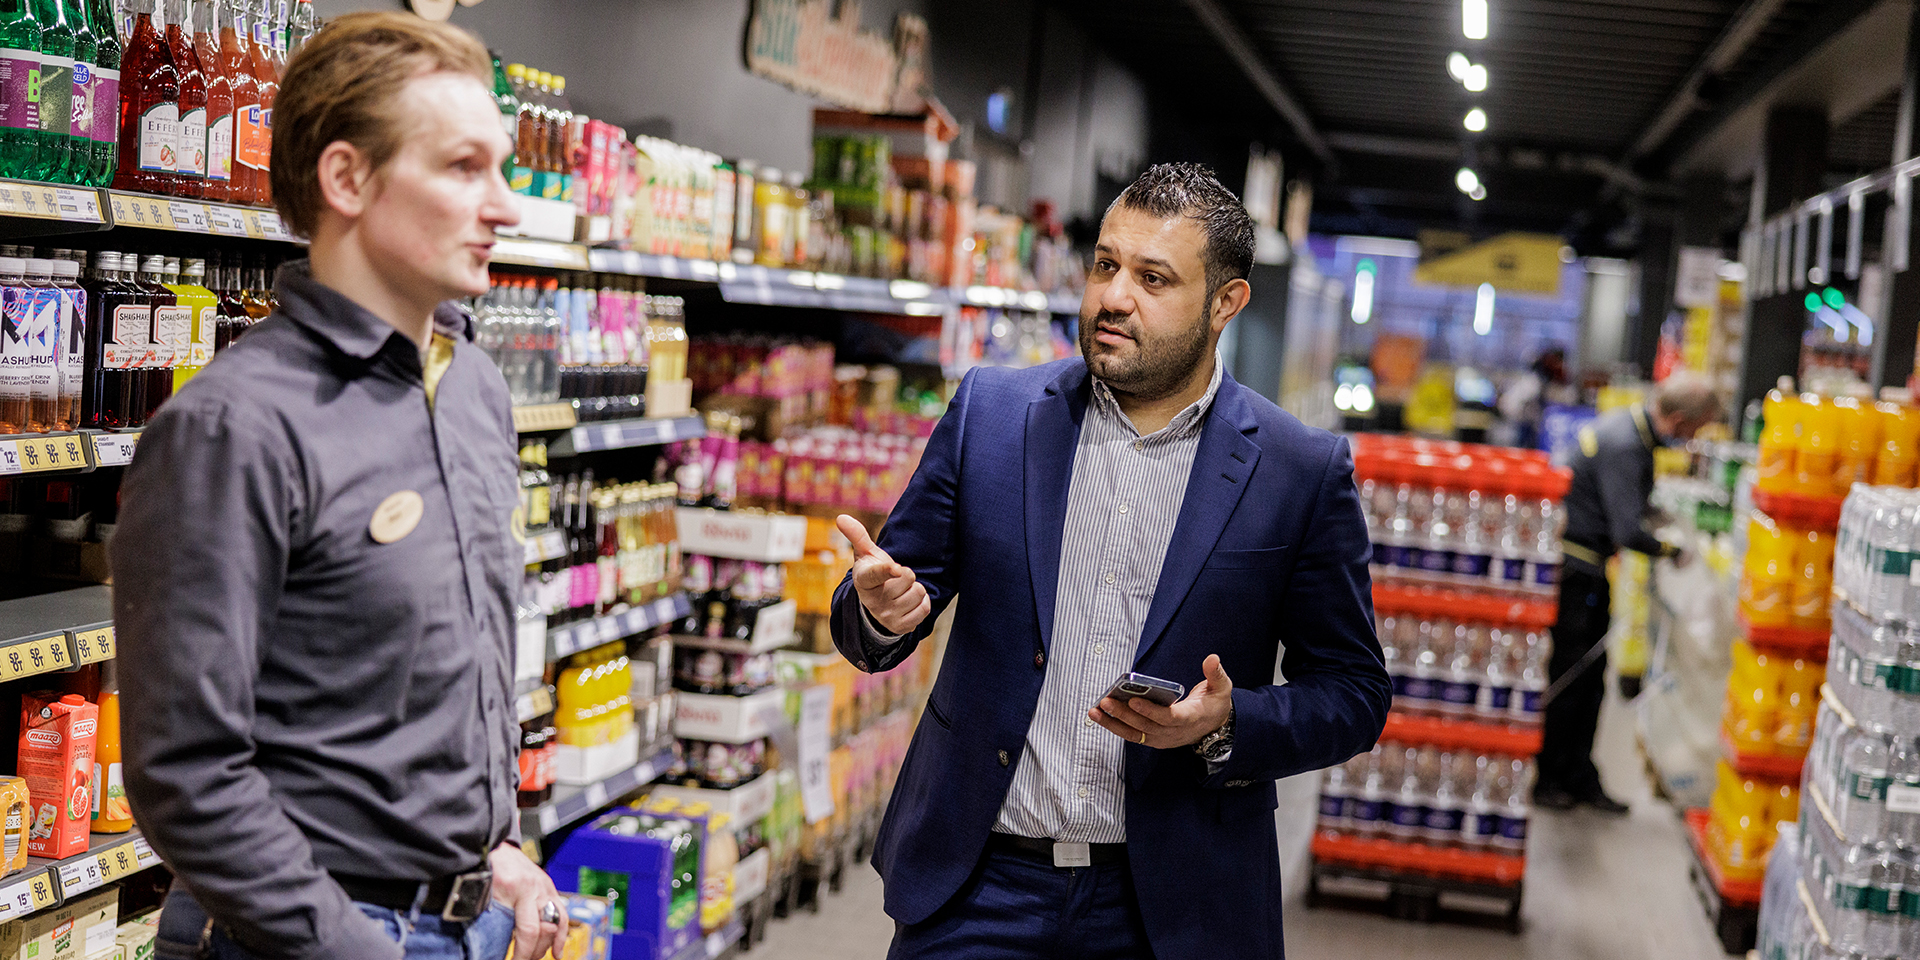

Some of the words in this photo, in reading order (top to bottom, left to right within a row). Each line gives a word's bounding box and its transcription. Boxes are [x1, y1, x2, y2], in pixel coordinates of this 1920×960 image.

[22, 190, 32, 201] SP
[43, 193, 53, 204] SP
[26, 200, 36, 211] OT
[47, 202, 57, 213] OT
[87, 201, 94, 214] 8
[112, 200, 122, 210] SP
[131, 202, 140, 212] SP
[150, 204, 159, 214] SP
[116, 209, 126, 220] OT
[135, 211, 145, 222] OT
[153, 213, 163, 223] OT
[193, 213, 203, 225] 22
[232, 218, 242, 229] 22
[24, 445, 35, 457] SP
[45, 444, 55, 455] SP
[66, 442, 75, 453] SP
[120, 444, 131, 456] 50
[4, 451, 15, 464] 12
[29, 454, 39, 465] OT
[50, 452, 59, 463] OT
[70, 451, 79, 462] OT
[78, 639, 87, 650] SP
[97, 635, 106, 646] SP
[30, 648, 40, 659] SP
[50, 643, 60, 654] SP
[82, 647, 91, 658] OT
[101, 643, 110, 653] OT
[9, 652, 19, 663] SP
[34, 656, 43, 667] OT
[54, 651, 63, 662] OT
[13, 661, 23, 672] OT
[74, 723, 94, 735] maaza
[30, 732, 58, 744] maaza
[116, 851, 125, 862] SP
[98, 858, 107, 870] SP
[119, 858, 129, 870] OT
[86, 866, 96, 879] 15
[101, 865, 111, 877] OT
[34, 881, 43, 893] SP
[17, 893, 27, 907] 15
[38, 889, 48, 901] OT
